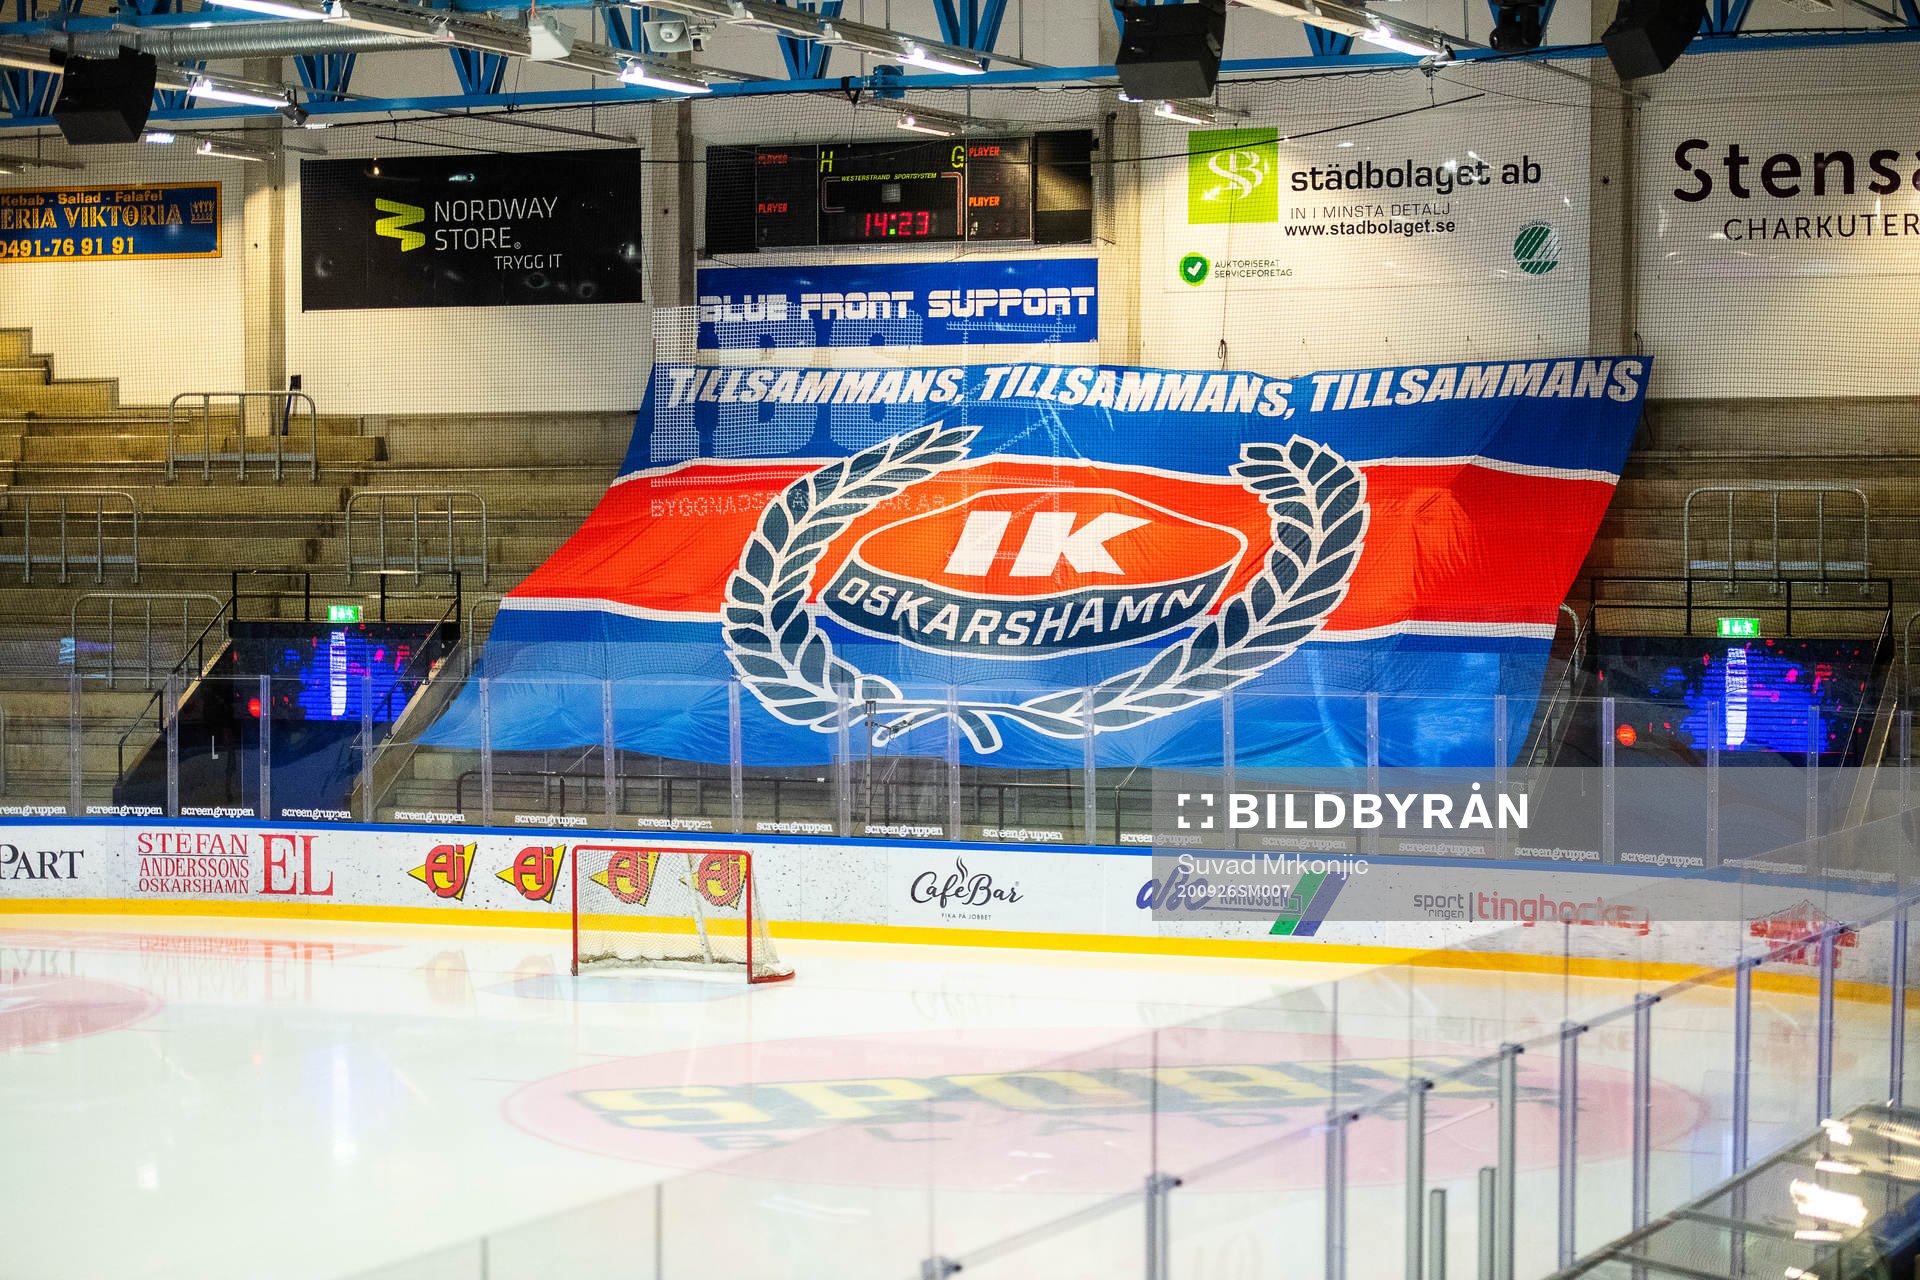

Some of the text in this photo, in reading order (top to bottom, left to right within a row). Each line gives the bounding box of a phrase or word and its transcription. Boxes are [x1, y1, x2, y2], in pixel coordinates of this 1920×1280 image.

[951, 145, 964, 168] G
[969, 147, 999, 157] PLAYER
[820, 151, 833, 172] H
[841, 173, 890, 182] WESTERSTRAND
[1291, 156, 1542, 195] städbolaget ab
[1674, 139, 1920, 202] Stens
[1, 195, 45, 206] Kebab
[58, 192, 101, 204] Sallad
[115, 190, 163, 202] Falafel
[969, 196, 999, 207] PLAYER
[63, 203, 183, 228] VIKTORIA
[435, 197, 558, 222] NORDWAY
[758, 204, 788, 213] PLAYER
[1290, 207, 1306, 219] IN
[1322, 204, 1385, 218] MINSTA
[1391, 202, 1451, 216] DETALJ
[865, 211, 929, 236] 14:23
[1284, 220, 1456, 237] www.stadbolaget.se
[81, 237, 103, 255] 91
[112, 236, 134, 254] 91
[494, 254, 563, 270] TRYGG IT
[1214, 259, 1280, 268] AUKTORISERAT
[700, 286, 1095, 322] BLUE FRONT SUPPORT
[667, 360, 1642, 421] TILLSAMMANS, TILLSAMMANS, TILLSAMMANS
[944, 510, 1153, 577] IK
[837, 577, 1207, 647] OSKARSHAMN
[86, 804, 163, 817] screengruppen
[181, 805, 254, 818] screengruppen
[282, 807, 352, 820] screengruppen
[394, 810, 465, 823] screengruppen
[514, 813, 588, 827] screengruppen
[638, 817, 713, 830] screengruppen
[756, 821, 833, 834] screengruppen
[864, 824, 943, 837] screengruppen
[982, 827, 1063, 841] screengruppen
[138, 832, 248, 855] STEFAN
[1514, 845, 1600, 861] screengruppen
[1621, 851, 1704, 868] screengruppen
[139, 857, 249, 878] ANDERSSONS
[259, 833, 334, 896] EL
[138, 878, 249, 894] OSKARSHAMN
[1413, 893, 1464, 909] sport
[1428, 909, 1464, 923] ringen
